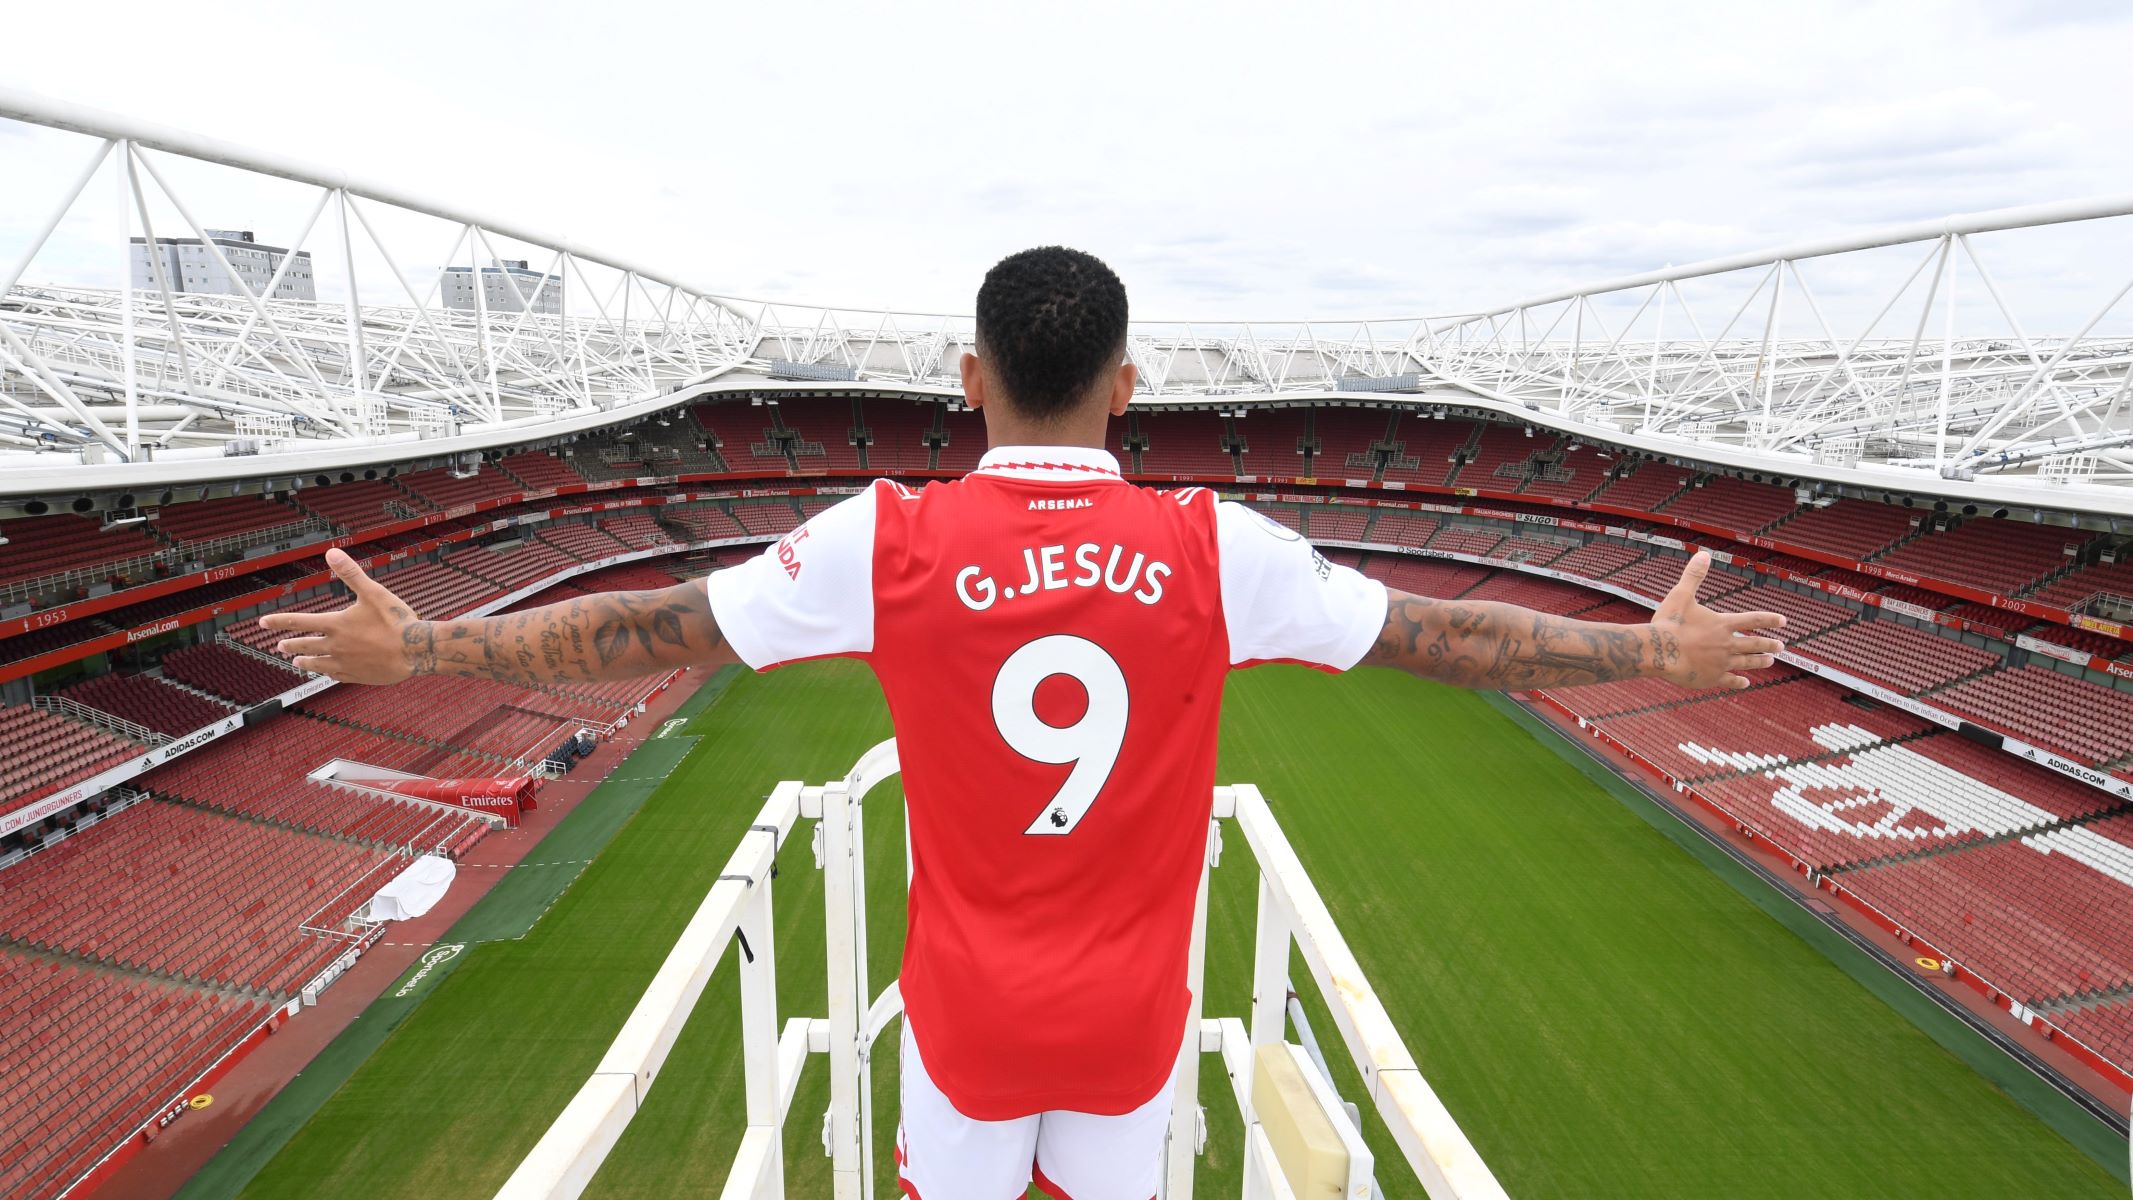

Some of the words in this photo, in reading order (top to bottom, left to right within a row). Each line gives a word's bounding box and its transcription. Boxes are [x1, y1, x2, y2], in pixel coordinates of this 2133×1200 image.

[1028, 497, 1094, 511] ARSENAL
[1523, 515, 1552, 525] SLIGO
[777, 538, 802, 582] NDA
[213, 566, 235, 580] 1970
[955, 542, 1172, 612] G.JESUS
[1864, 564, 1882, 577] 1998
[1787, 572, 1821, 589] Arsenal.com
[2001, 599, 2026, 613] 2002
[37, 609, 68, 628] 1953
[127, 619, 180, 643] Arsenal.com
[1880, 691, 1903, 706] Emirates
[1920, 706, 1939, 719] Indian
[1939, 713, 1958, 728] Ocean
[990, 632, 1131, 836] 9
[164, 729, 216, 759] ADIDAS.COM
[2047, 758, 2106, 787] ADIDAS.COM
[461, 794, 513, 807] Emirates
